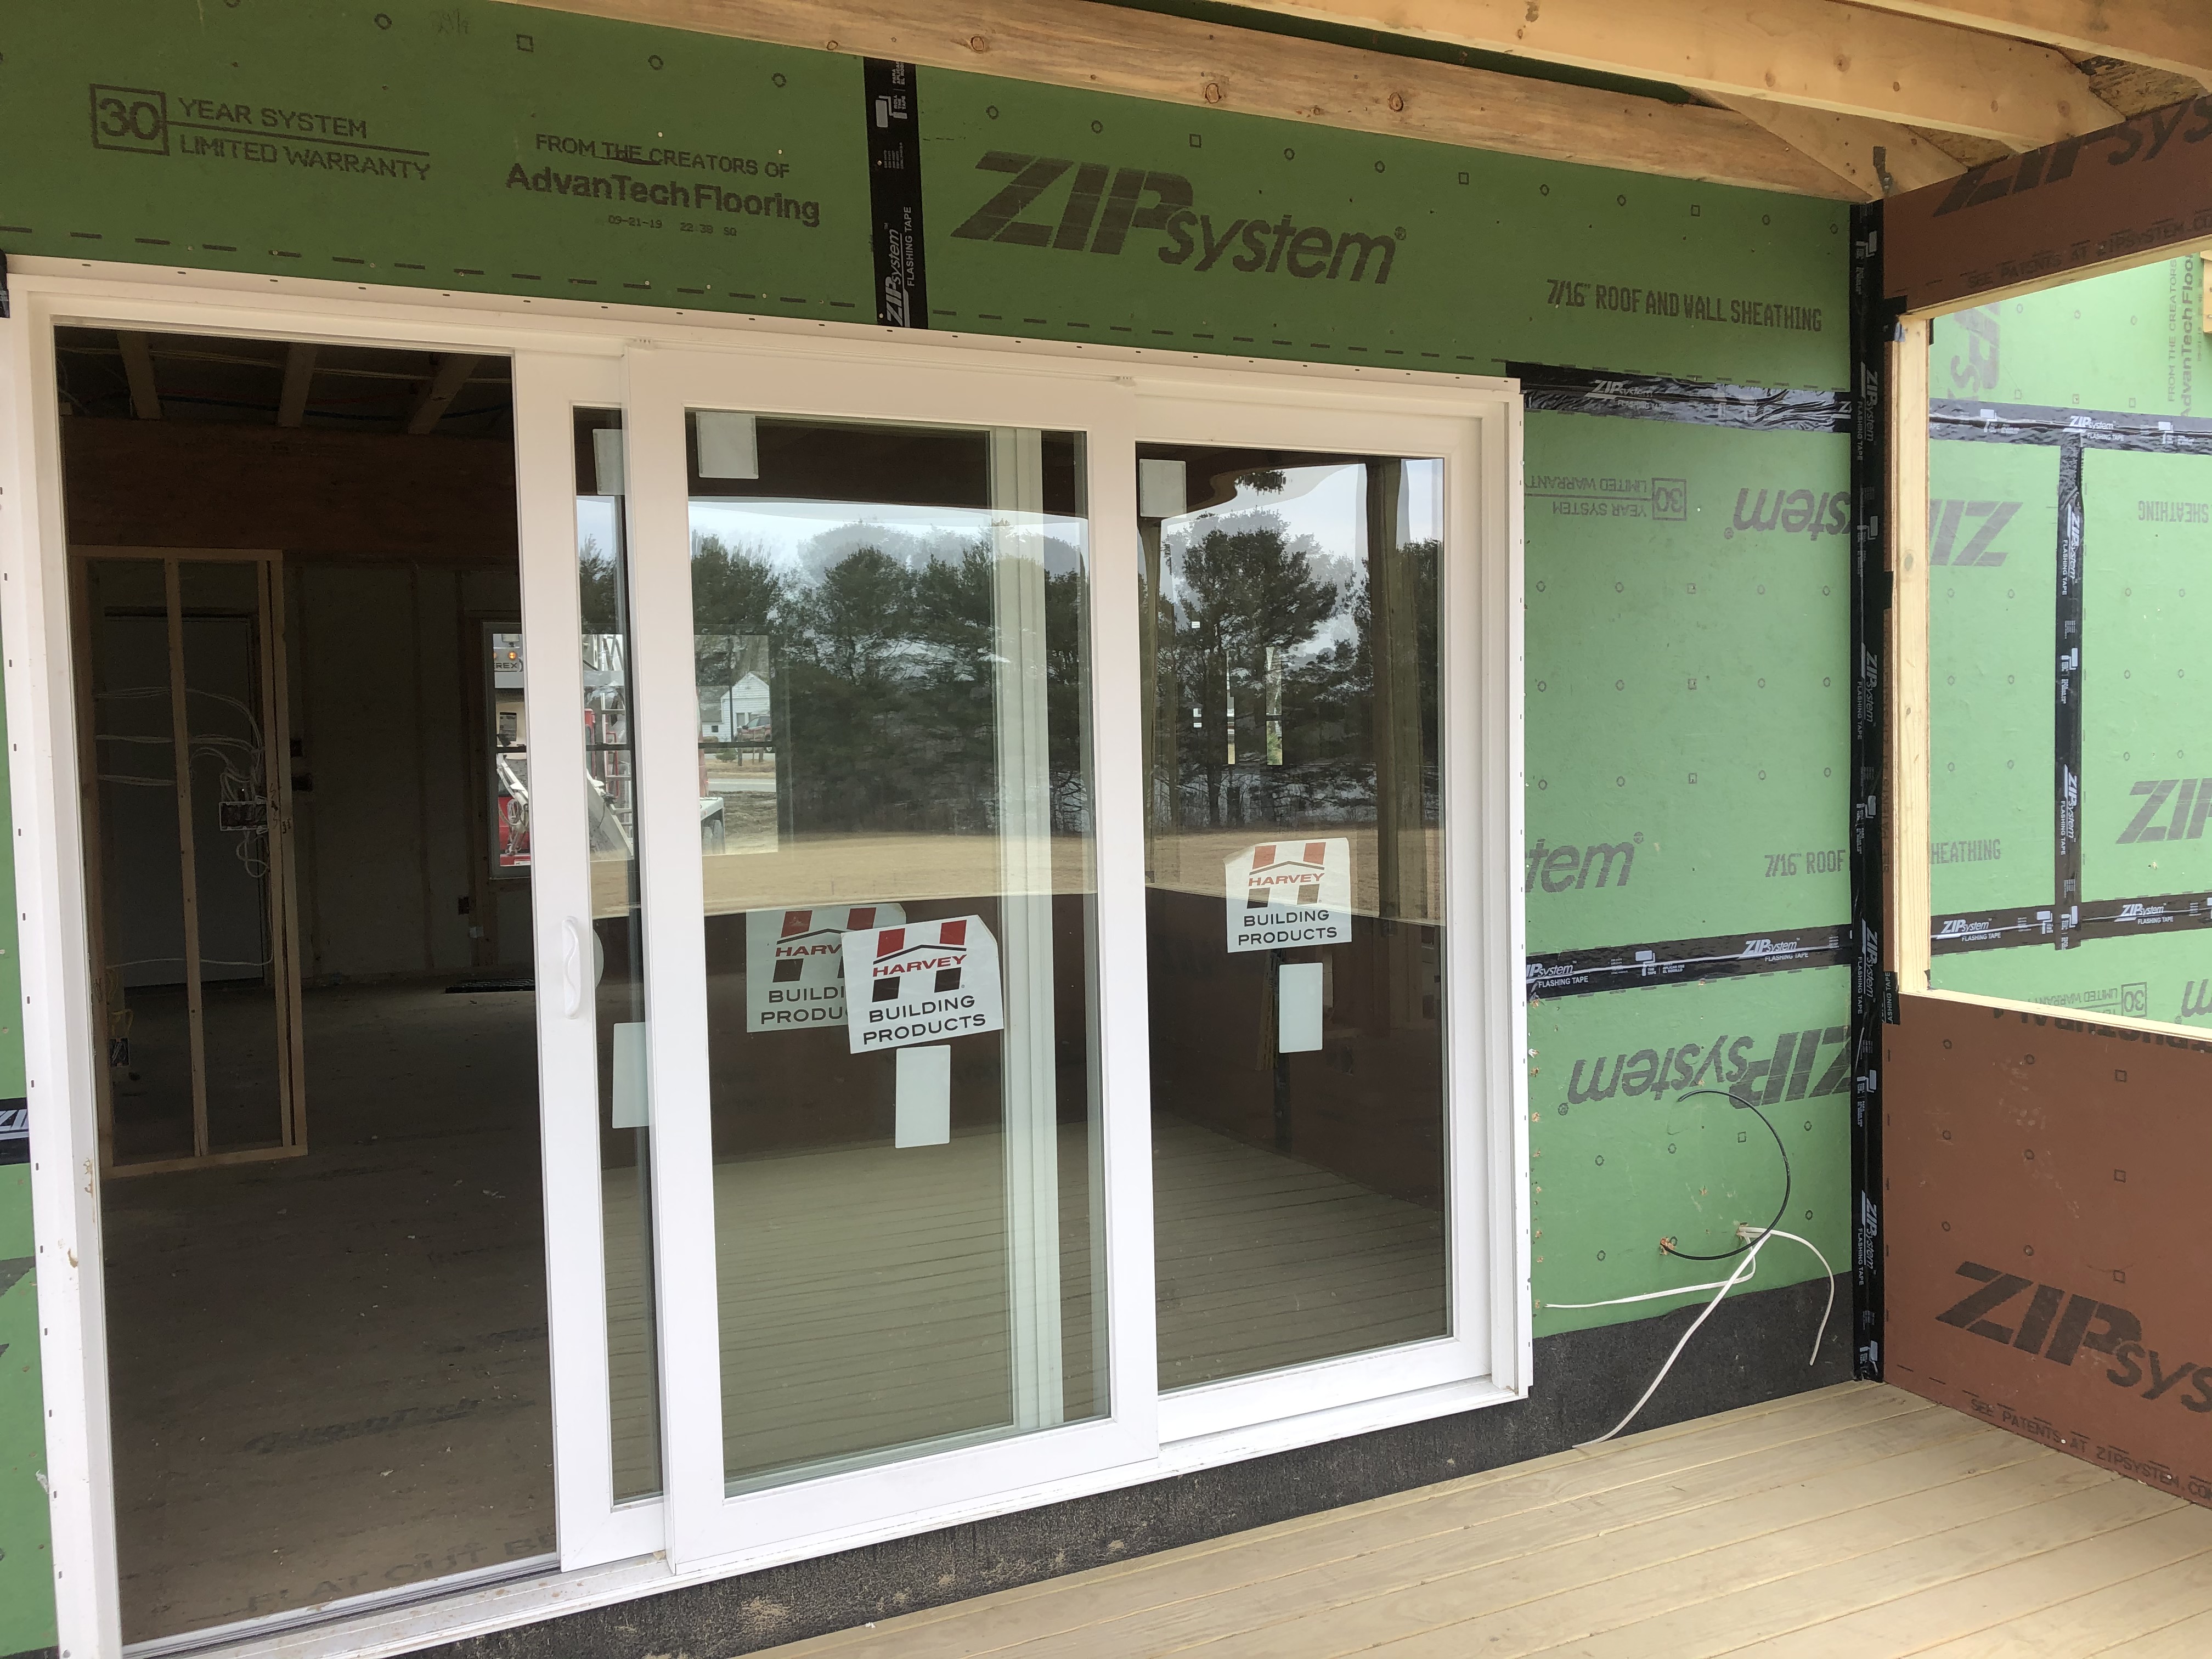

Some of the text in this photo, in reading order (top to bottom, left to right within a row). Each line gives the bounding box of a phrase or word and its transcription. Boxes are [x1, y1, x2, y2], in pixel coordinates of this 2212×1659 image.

[99, 98, 159, 140] 30
[178, 97, 366, 139] YEAR SYSTEM
[180, 134, 431, 180] LIMITED WARRANTY
[535, 133, 789, 178] FROM THE CREATORS OF
[903, 206, 915, 287] FLASHING TAPE
[2168, 258, 2177, 331] CREATORS
[1595, 285, 1643, 313] ROOF
[1645, 290, 1680, 317] AND
[1683, 294, 1728, 323] WALL
[1730, 300, 1822, 332] SHEATHING
[2168, 336, 2176, 362] THE
[1600, 478, 1648, 492] LIMITED
[1552, 501, 1646, 517] YEAR SYSTEM
[1656, 487, 1684, 513] 30
[2138, 500, 2209, 523] SHEATHING
[1806, 849, 1847, 874] ROOF
[1248, 872, 1325, 887] HARVEY
[1244, 910, 1330, 927] BUILDING
[2137, 917, 2162, 925] FLASHING
[1238, 927, 1338, 946] PRODUCTS
[1961, 931, 2001, 942] FLASHING TAPE
[775, 944, 843, 957] HARV
[1764, 953, 1793, 962] FLASHING
[872, 954, 968, 977] HARVEY
[1538, 975, 1589, 988] FLASHING TAPE
[2084, 988, 2118, 1002] LIMITED
[2123, 990, 2144, 1012] 30
[760, 1007, 848, 1025] PRODU
[869, 995, 976, 1023] BUILDING
[862, 1013, 986, 1045] PRODUCTS
[1971, 1397, 1995, 1416] SEE
[2002, 1409, 2062, 1443] PATENTS
[2069, 1437, 2087, 1454] AT
